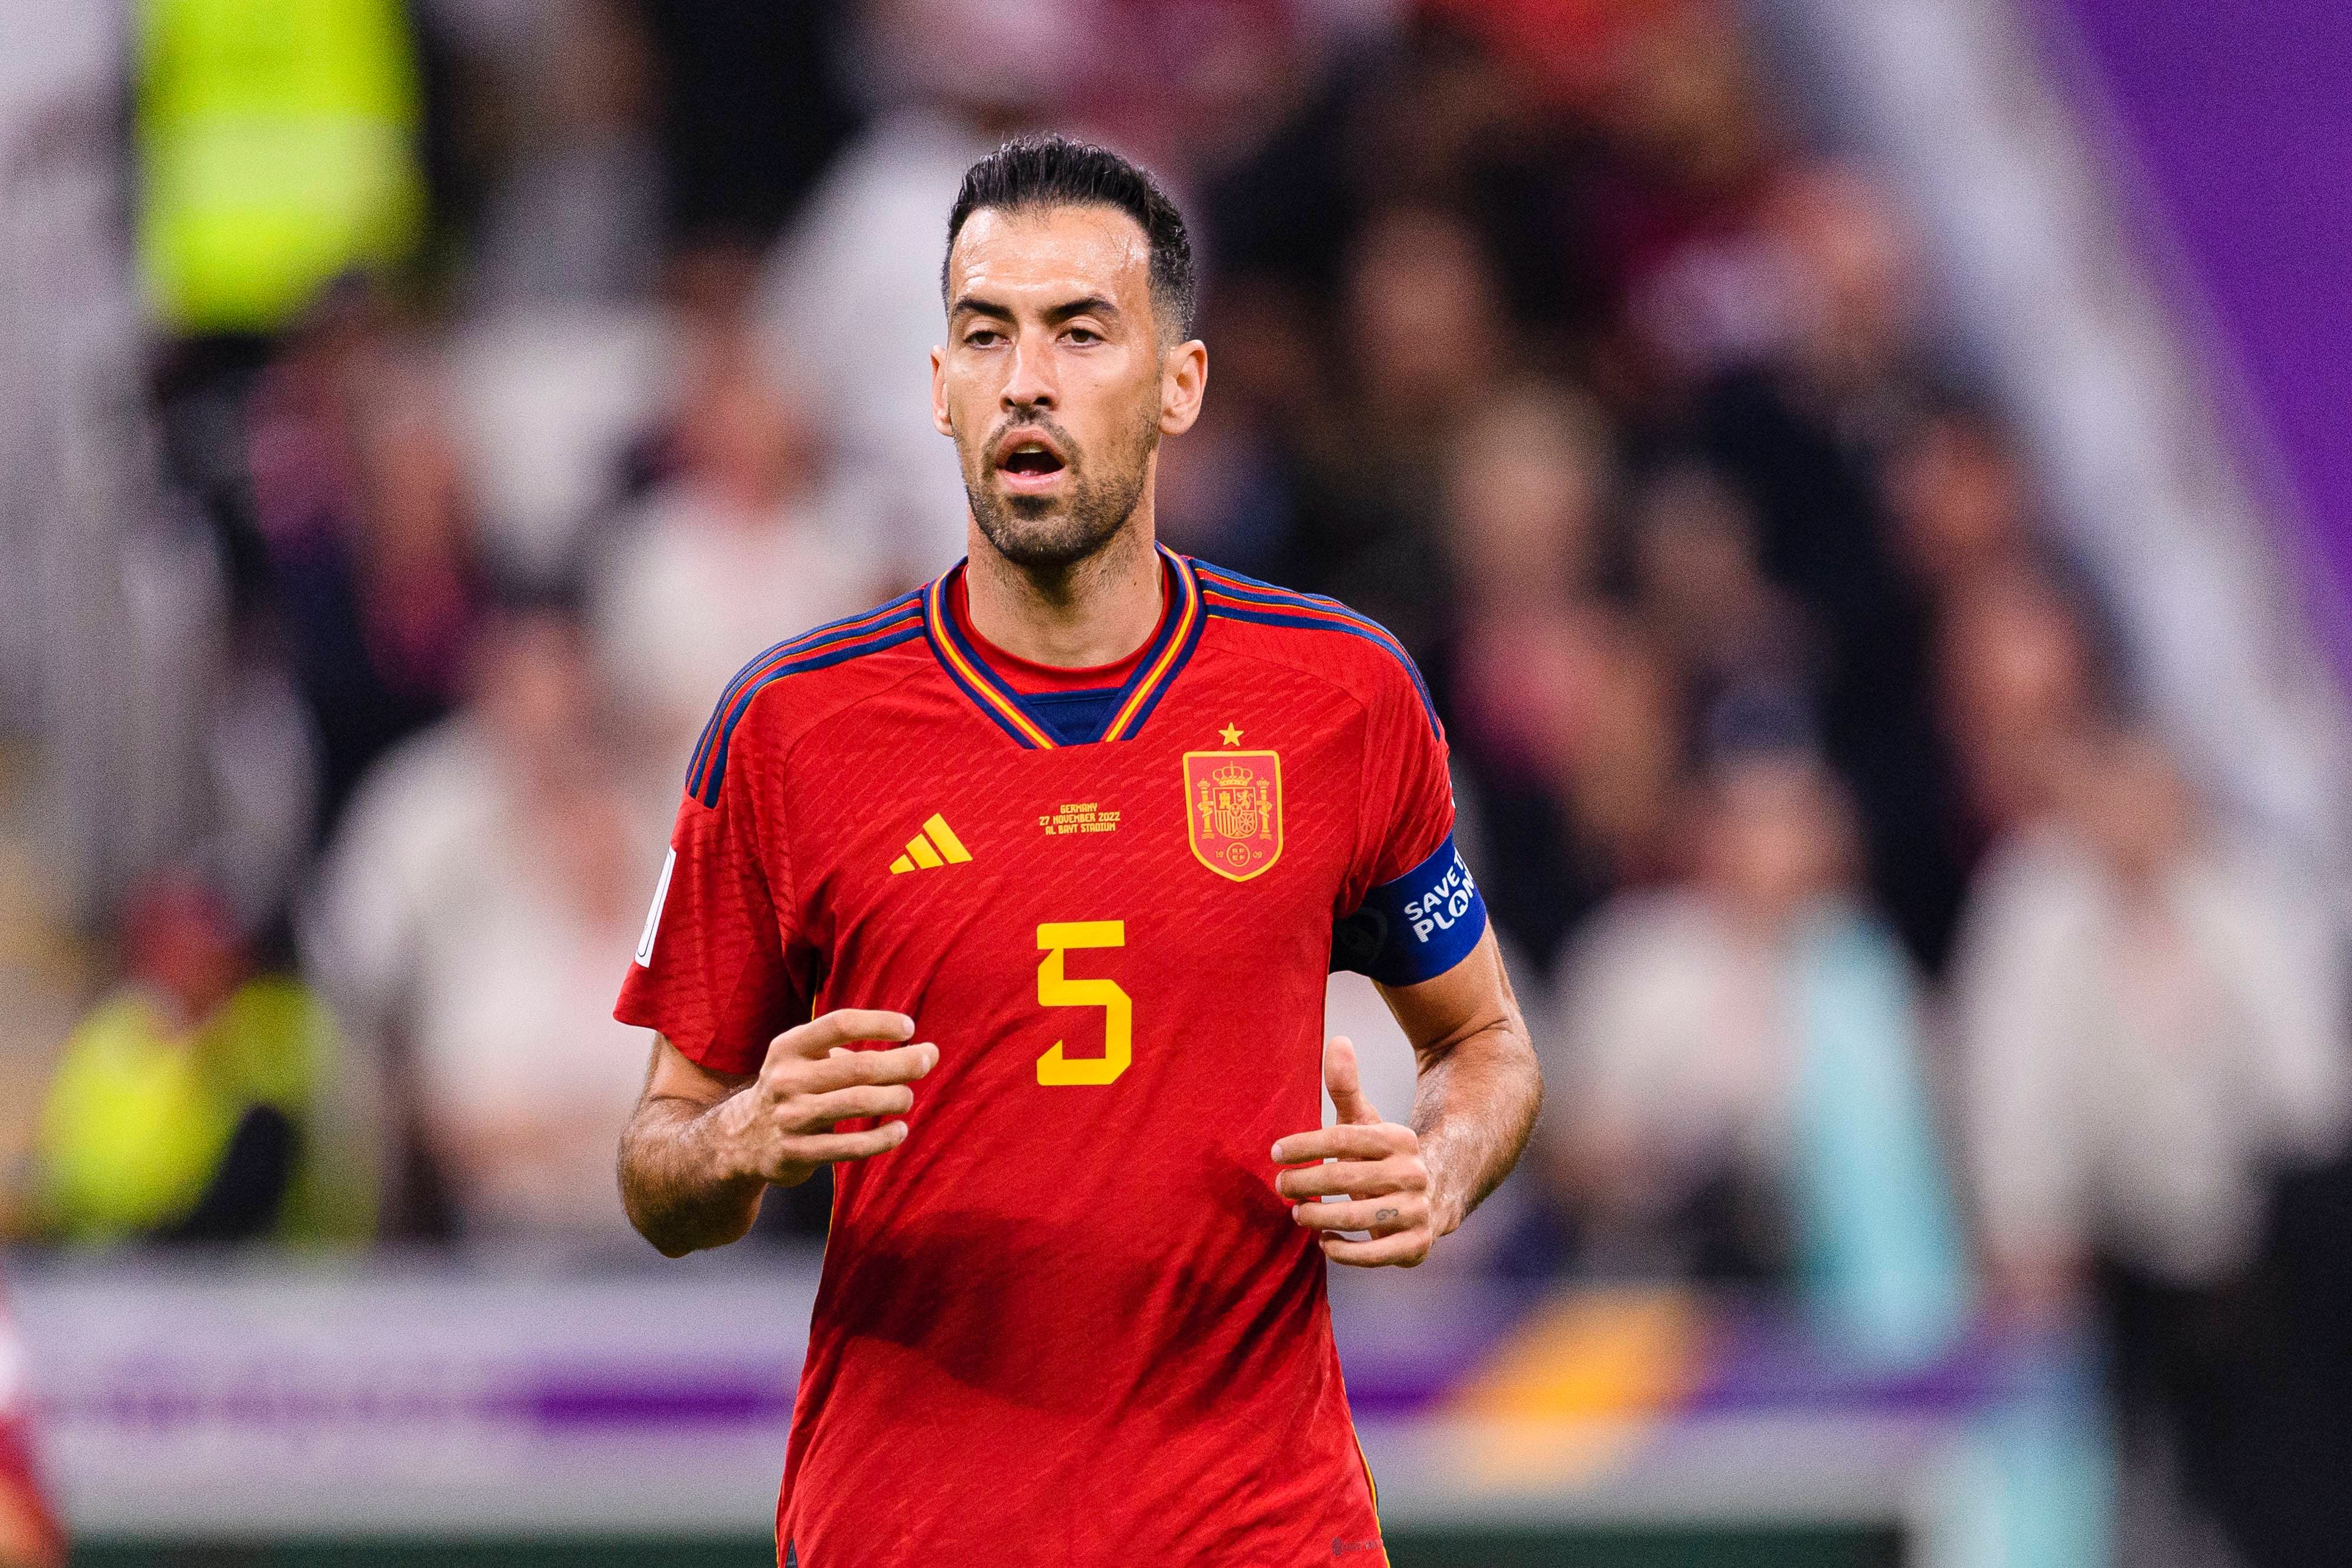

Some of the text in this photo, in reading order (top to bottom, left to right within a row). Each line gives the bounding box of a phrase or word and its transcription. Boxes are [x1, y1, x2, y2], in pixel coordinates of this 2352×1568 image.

[1039, 812, 1120, 826] 27 NOVEMBER 2022
[1060, 803, 1098, 814] GERMANY
[1045, 823, 1115, 835] AL BAYT STADIUM
[1404, 865, 1460, 921] SAVE
[1413, 862, 1475, 942] PLAN
[1037, 920, 1132, 1086] 5
